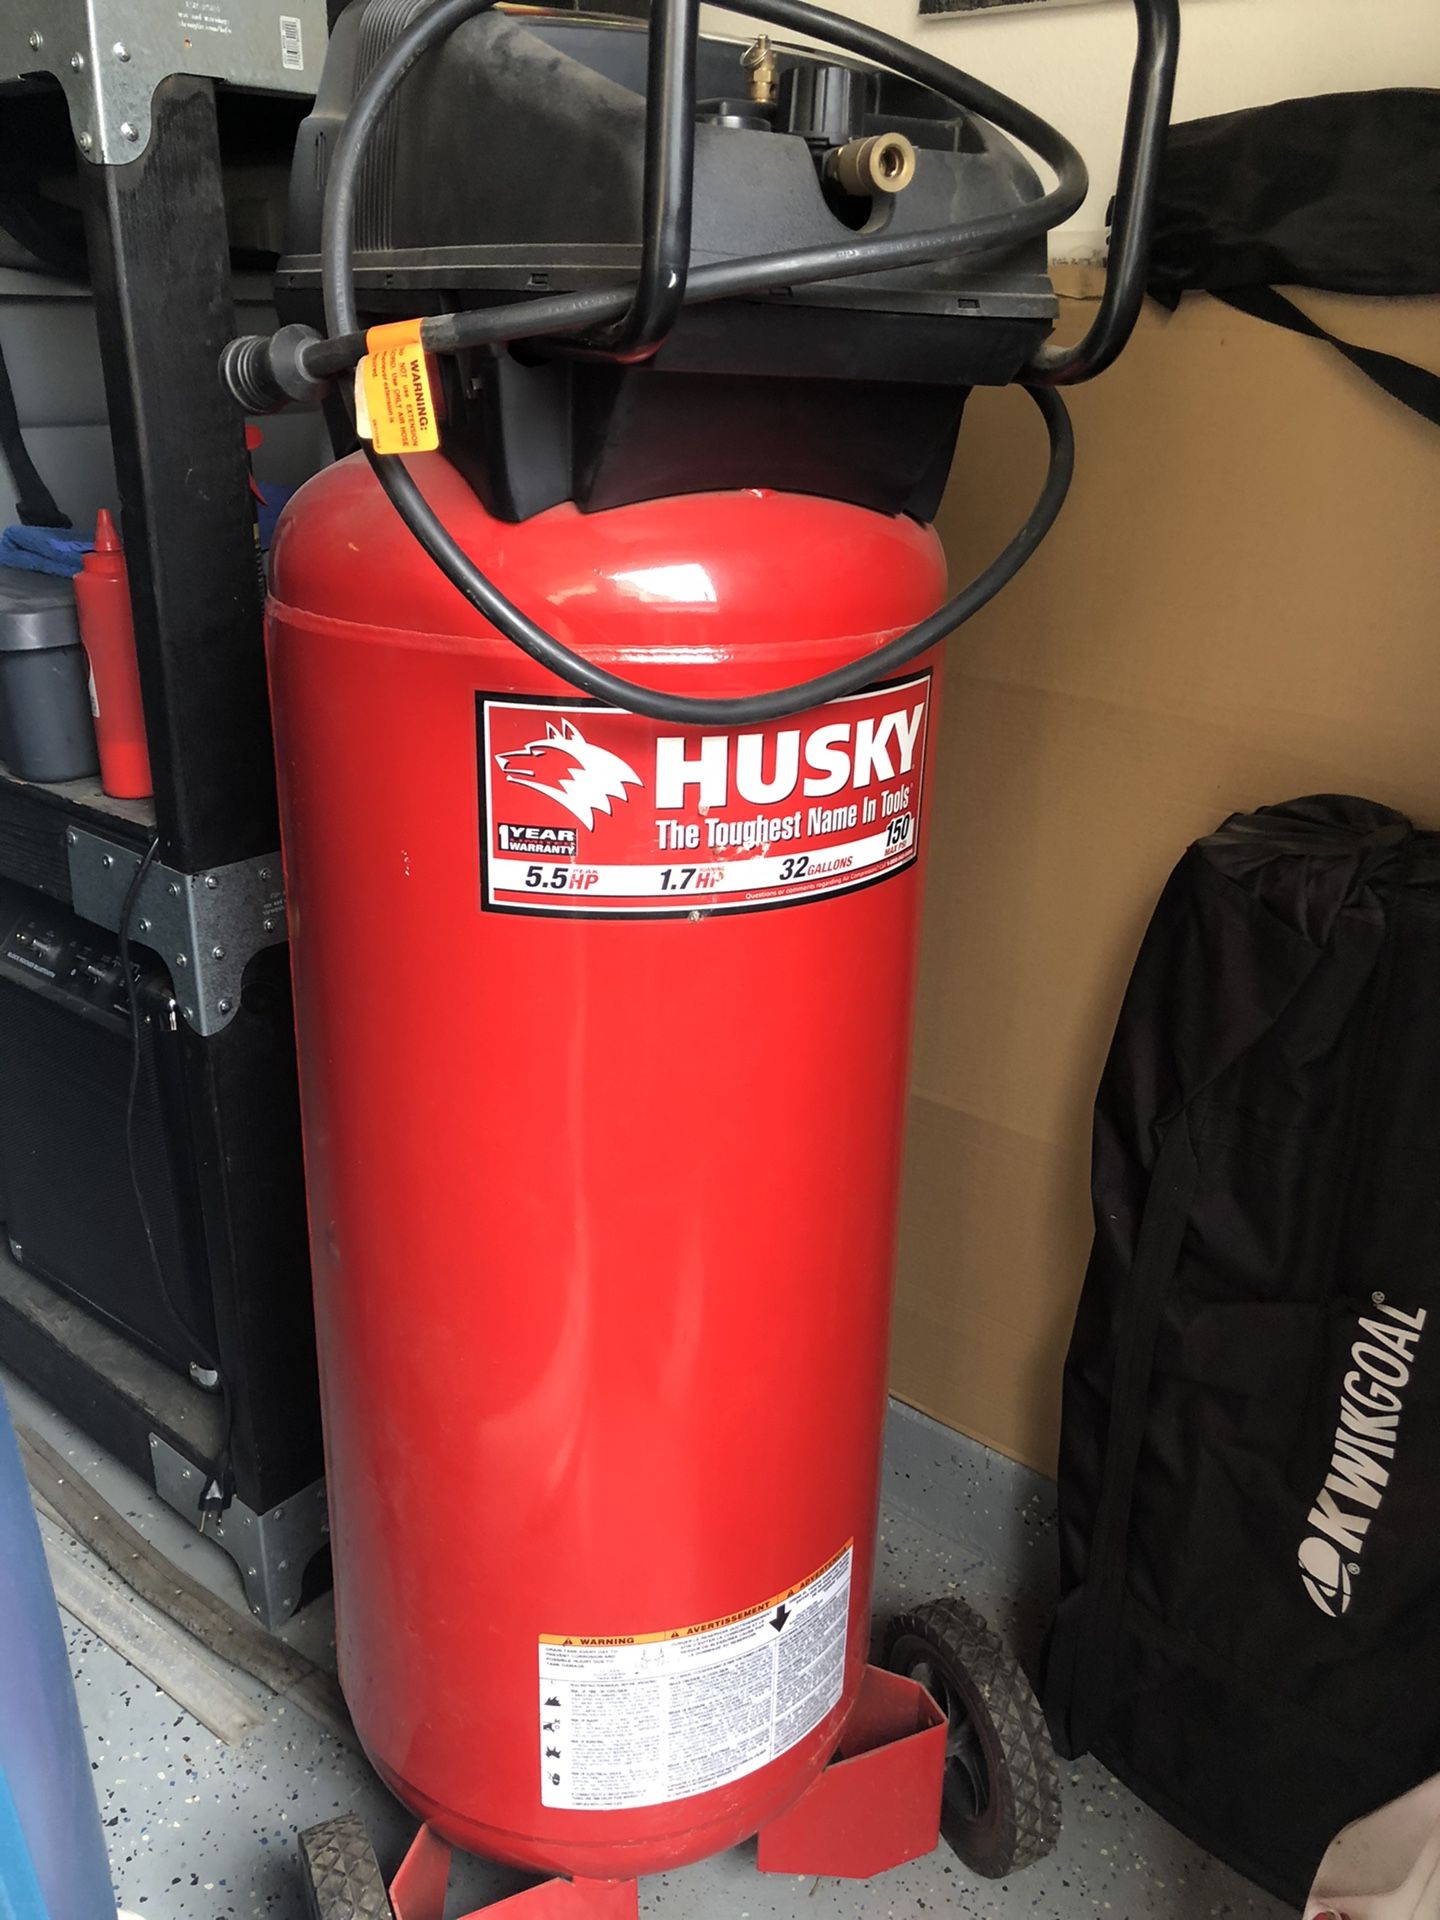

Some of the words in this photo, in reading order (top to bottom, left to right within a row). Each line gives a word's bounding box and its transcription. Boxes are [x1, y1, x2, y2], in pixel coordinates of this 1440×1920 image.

[400, 362, 408, 378] NOT
[406, 404, 419, 447] EXTENSION
[410, 359, 429, 431] WARNING:
[655, 702, 925, 809] HUSKY
[655, 818, 700, 850] The
[704, 812, 801, 850] Toughest
[807, 804, 858, 839] Name
[862, 796, 877, 825] In
[881, 784, 911, 818] Tools
[886, 813, 910, 847] 150
[499, 824, 509, 850] 1
[510, 826, 575, 842] YEAR
[510, 842, 575, 855] WARRANTY
[525, 866, 568, 889] 5.5
[568, 873, 599, 890] HP
[660, 868, 697, 890] 1.7
[779, 856, 809, 880] 32
[807, 855, 853, 876] GALLONS
[1307, 1304, 1427, 1554] KWIKGOAL
[687, 1601, 770, 1634] AVERTISSEMENT
[580, 1637, 635, 1646] WARNING
